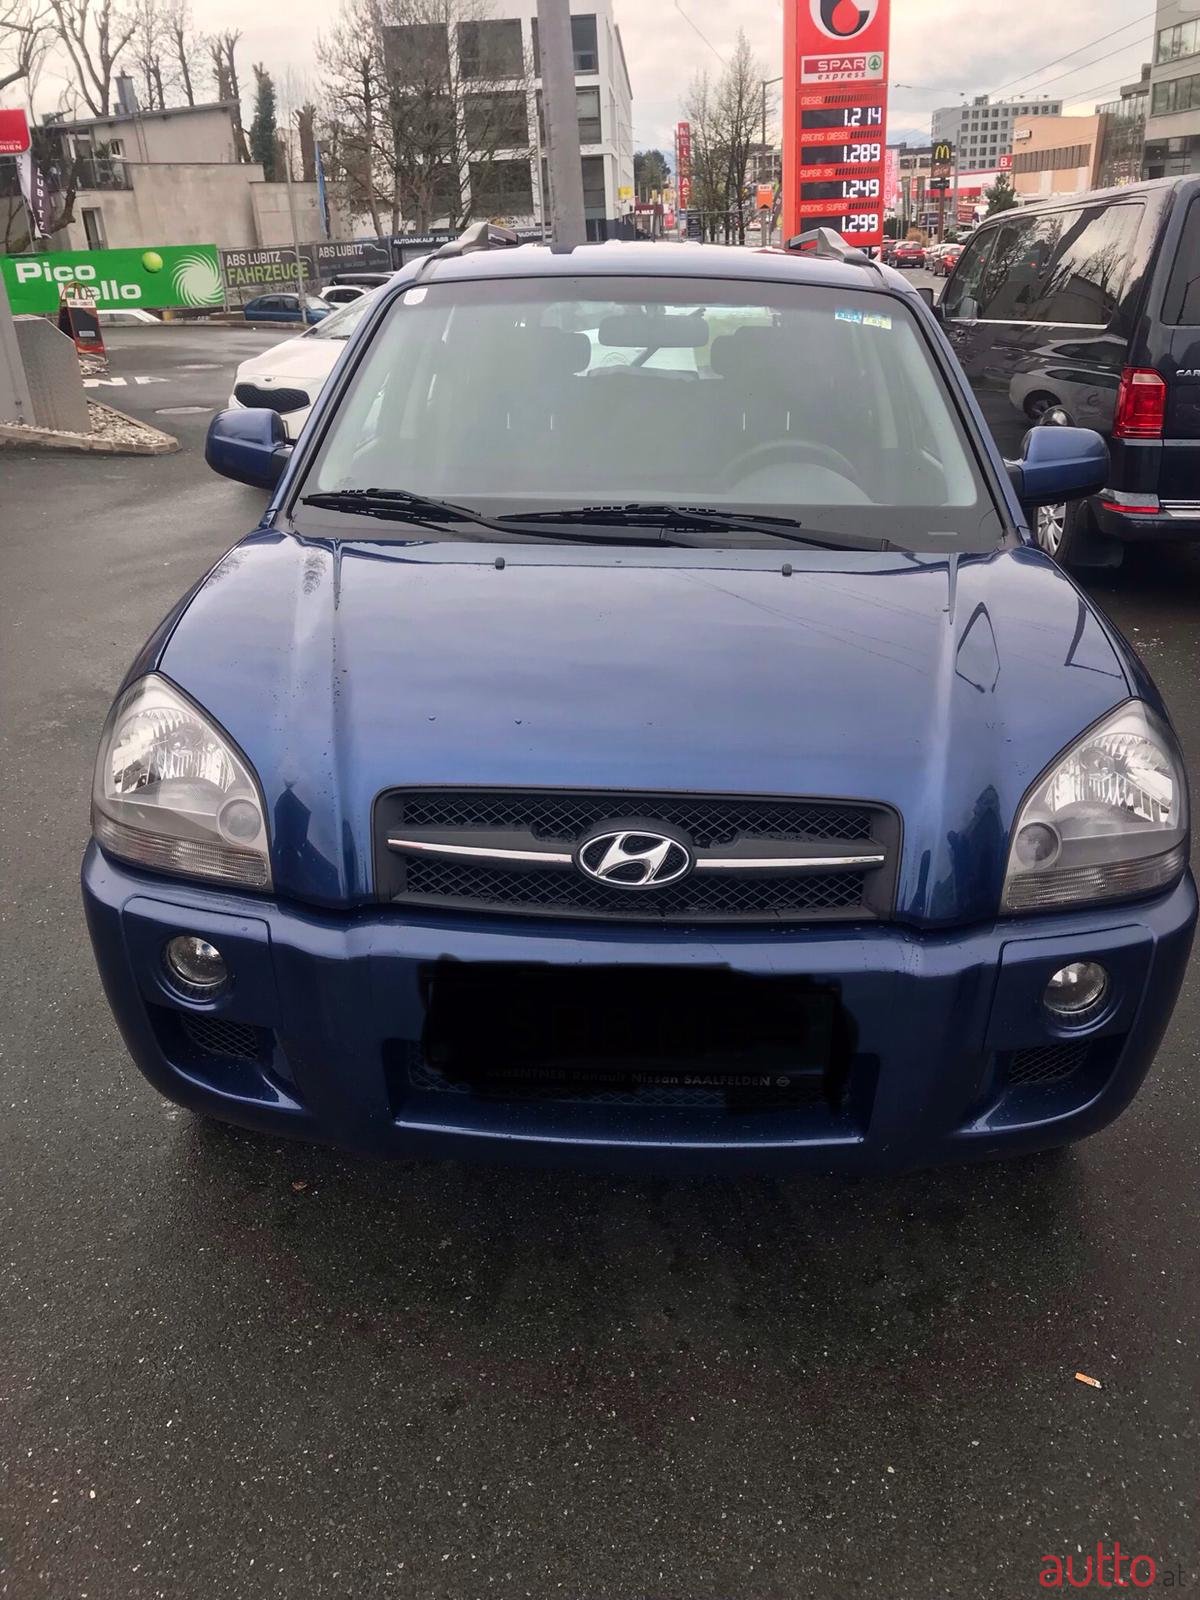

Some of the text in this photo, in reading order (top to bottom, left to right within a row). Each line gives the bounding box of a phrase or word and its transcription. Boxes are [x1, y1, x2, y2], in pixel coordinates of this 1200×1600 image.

[818, 59, 865, 71] SPAR
[818, 71, 866, 80] express
[801, 96, 824, 105] DIESEL
[844, 107, 881, 126] 1.214
[827, 132, 848, 140] DIESEL
[843, 143, 881, 163] 1.289
[800, 168, 833, 178] SUPER 95
[842, 178, 880, 198] 1.249
[36, 167, 45, 231] LUBITZ
[826, 202, 848, 212] SUPER
[841, 213, 879, 233] 1.299
[318, 244, 364, 258] ABS LUBITZ
[226, 251, 281, 267] ABS LUBITZ
[16, 262, 96, 283] Pico
[228, 261, 310, 286] FAHRZEUGE
[631, 1072, 678, 1084] Nissan
[684, 1074, 771, 1086] SAALFELDEN
